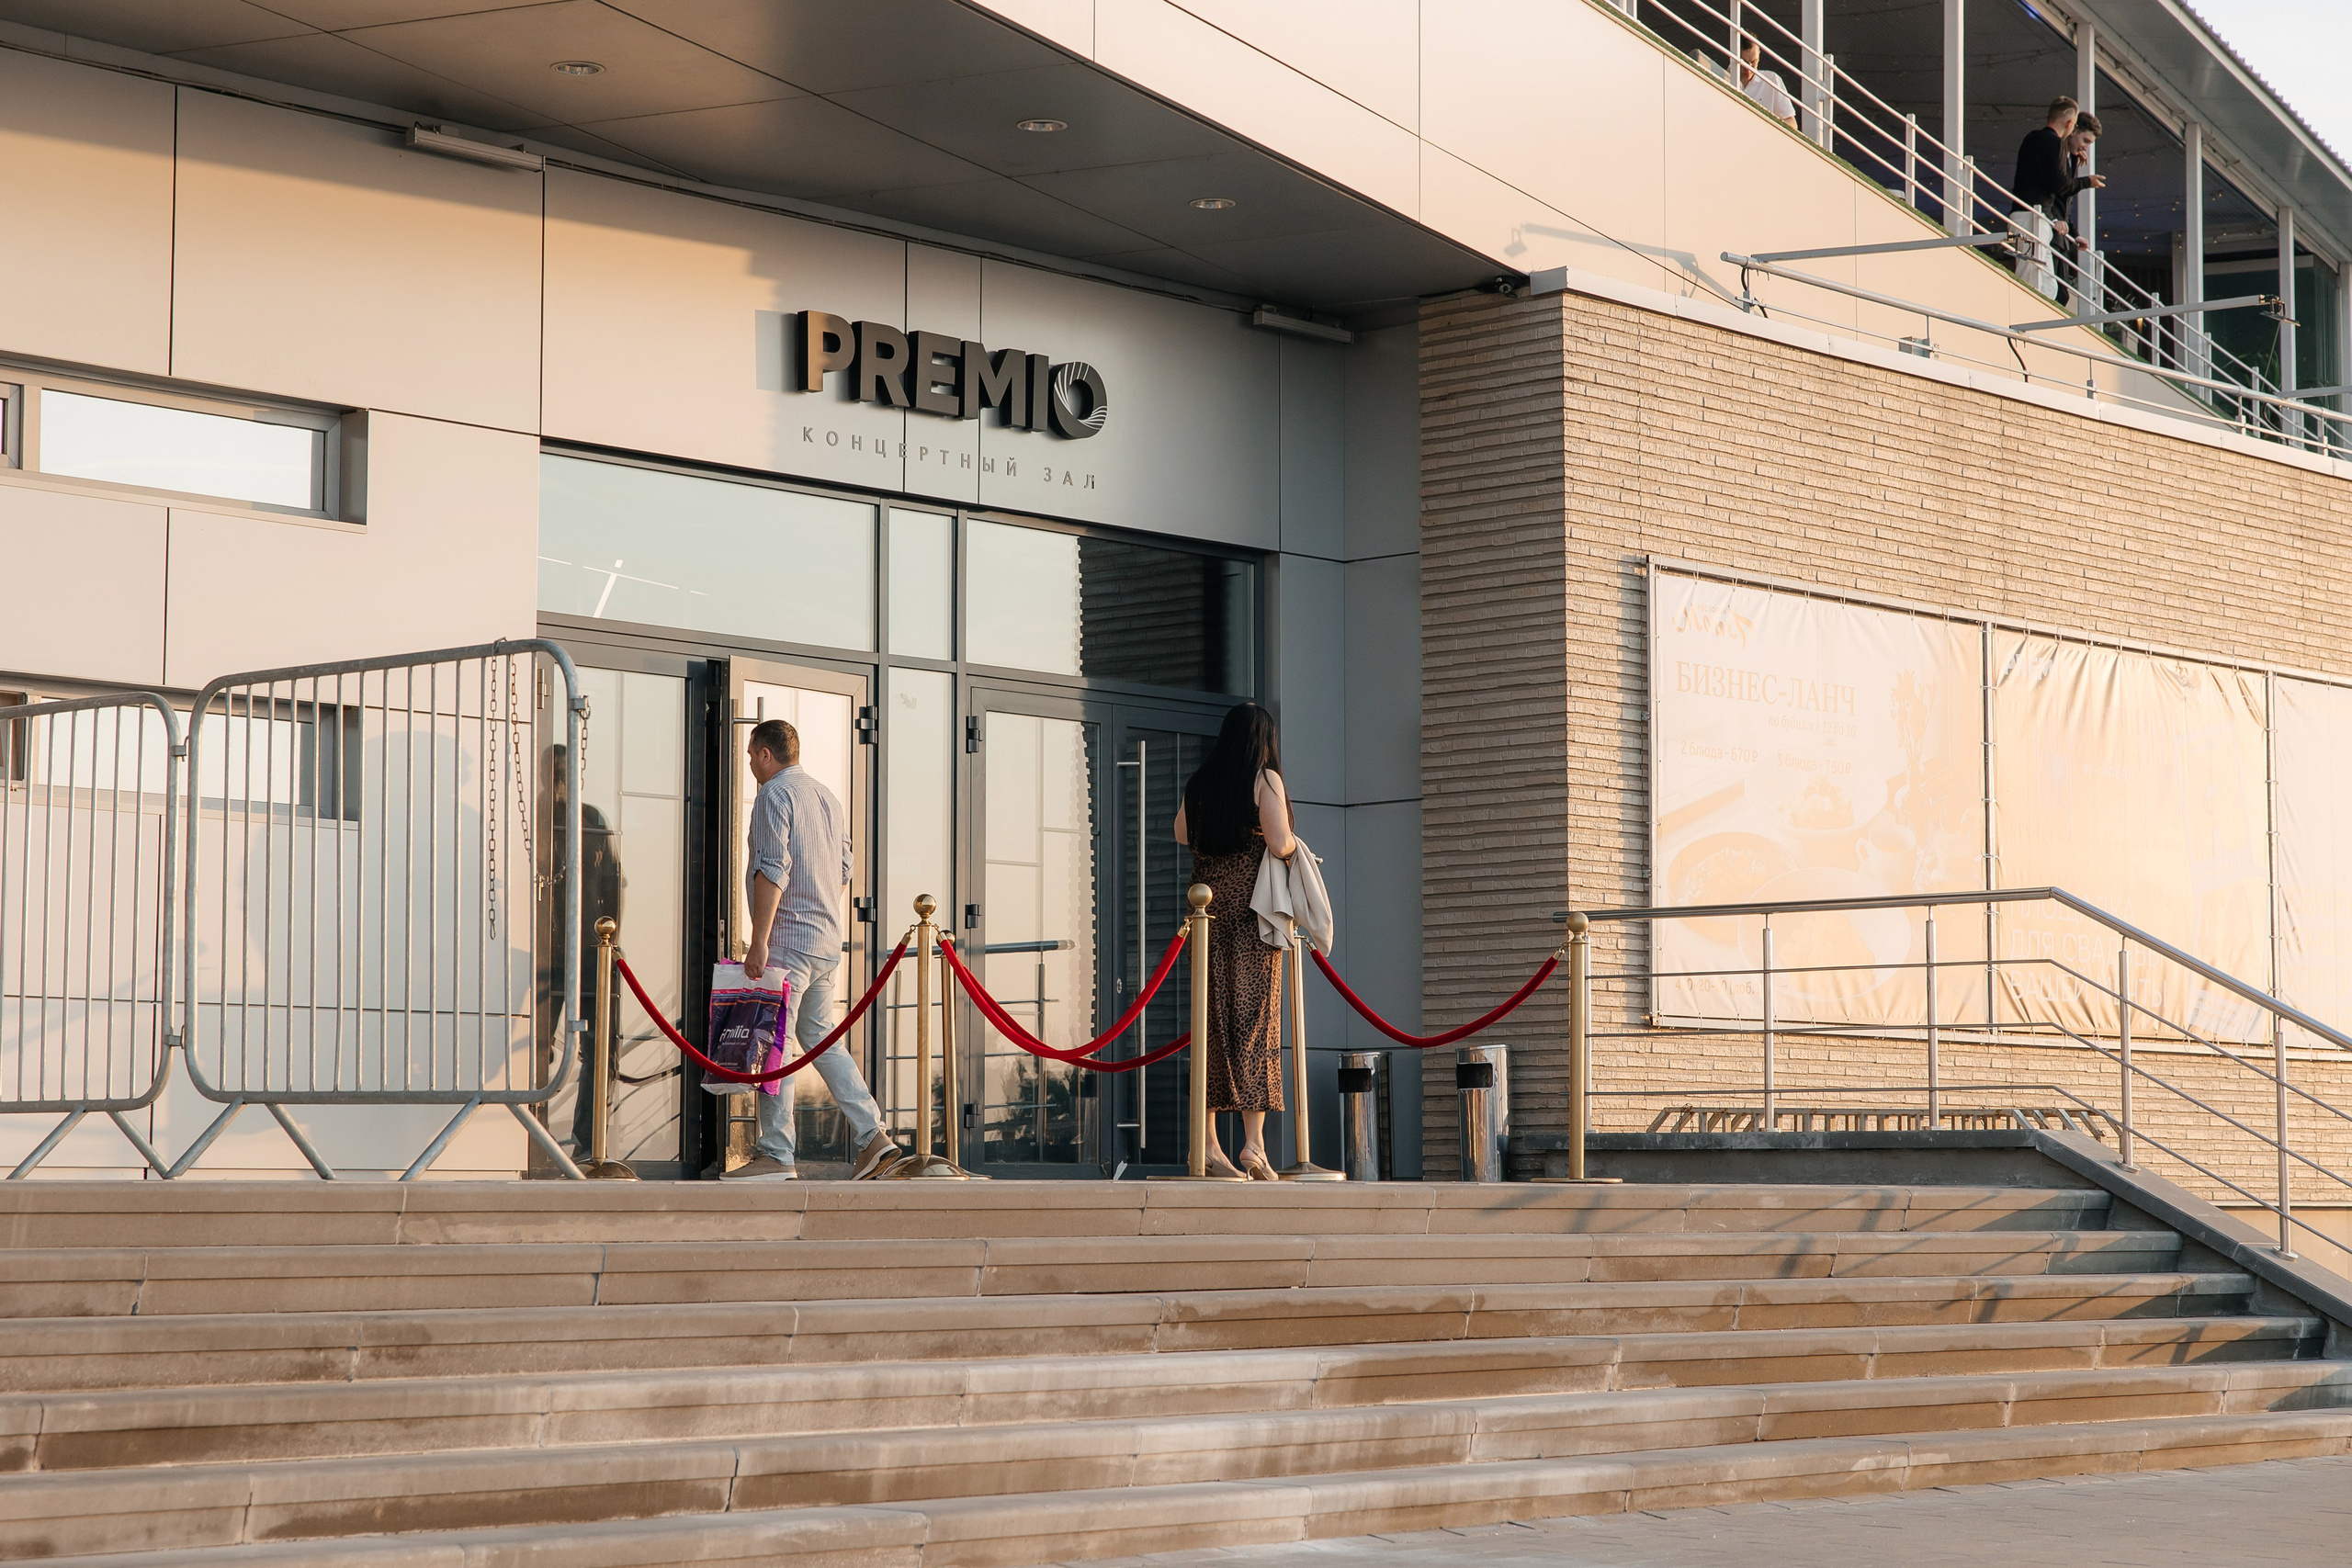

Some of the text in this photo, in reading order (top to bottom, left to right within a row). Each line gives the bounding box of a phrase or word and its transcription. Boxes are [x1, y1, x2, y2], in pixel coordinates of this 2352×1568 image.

[797, 310, 1108, 440] PREMIO
[802, 426, 1097, 490] КОНЦЕРТНЫЙ ЗАЛ
[1697, 604, 1727, 615] РЕСТОН
[1676, 660, 1856, 716] БИЗНЕС-ЛАНЧ
[1769, 716, 1780, 727] по
[1781, 715, 1814, 733] будням
[1822, 721, 1832, 734] 12
[1833, 722, 1844, 735] до
[1847, 724, 1856, 737] 16
[1680, 740, 1687, 755] 2
[1689, 742, 1723, 761] блюда
[1777, 752, 1782, 767] 3
[1785, 754, 1817, 772] блюда
[2010, 929, 2054, 959] ДЛЯ
[1675, 977, 1727, 992] 40-20-0
[2010, 966, 2166, 1008] ВАШЕЙ МТЫ
